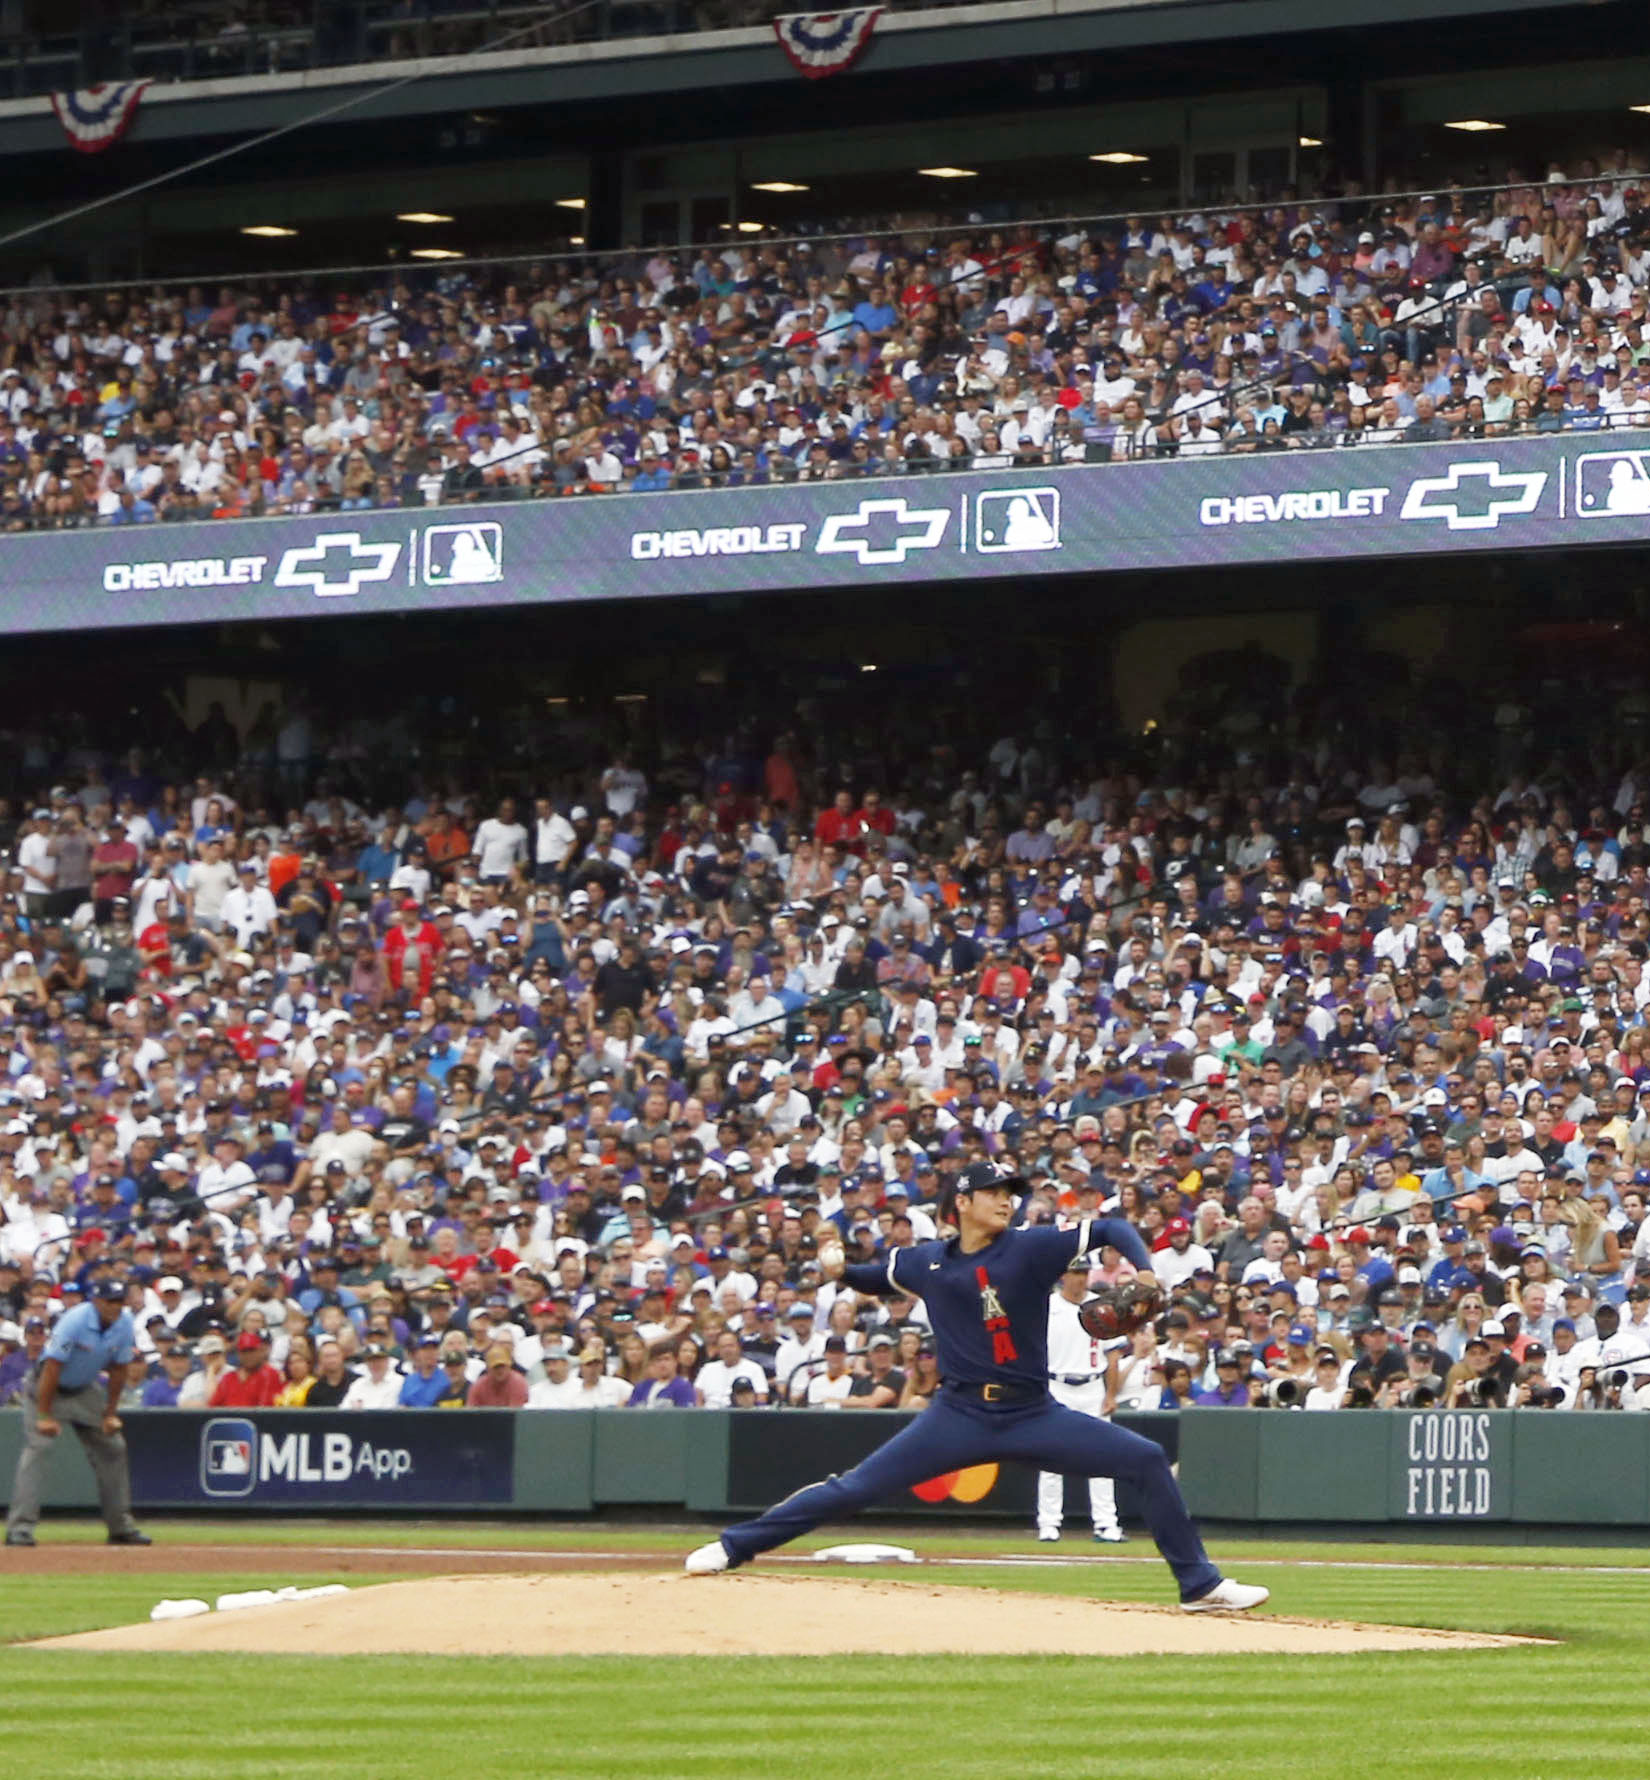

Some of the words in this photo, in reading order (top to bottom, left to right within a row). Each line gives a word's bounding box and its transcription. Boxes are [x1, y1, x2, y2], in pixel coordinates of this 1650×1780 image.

[1200, 488, 1391, 526] CHEVROLET
[632, 523, 808, 560] CHEVROLET
[103, 556, 269, 592] CHEVROLET
[260, 1432, 353, 1482] MLB
[354, 1441, 412, 1480] App
[1408, 1414, 1490, 1461] COORS
[1406, 1467, 1490, 1515] FIELD
